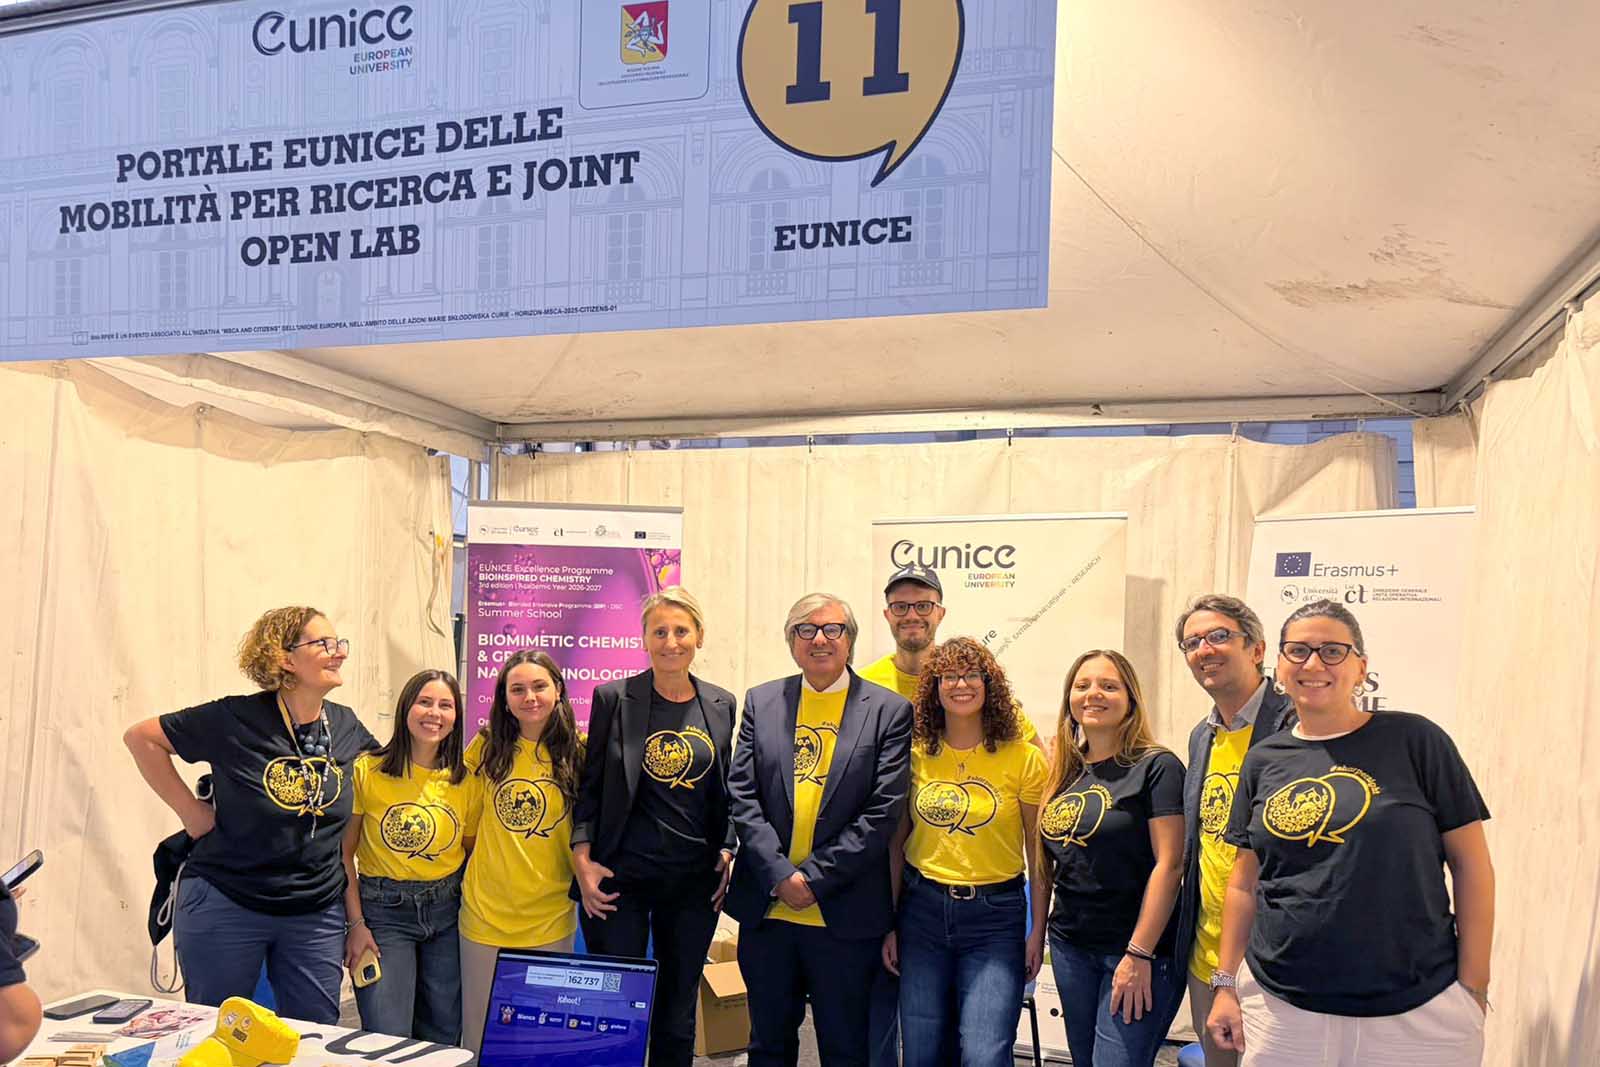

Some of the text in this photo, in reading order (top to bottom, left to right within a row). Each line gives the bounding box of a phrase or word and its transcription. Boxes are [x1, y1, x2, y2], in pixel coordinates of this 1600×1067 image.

[354, 47, 413, 63] EUROPEAN
[786, 0, 909, 104] 11
[350, 59, 413, 75] UNIVERSITY
[116, 107, 563, 183] PORTALE EUNICE DELLE
[59, 150, 640, 234] MOBILITÀ PER RICERCA E JOINT
[774, 216, 912, 251] EUNICE
[240, 224, 421, 267] OPEN LAB
[319, 322, 349, 330] EUROPEA,
[349, 319, 387, 328] NELL'AMBITO
[407, 316, 427, 324] AZIONI
[491, 311, 510, 319] CURIE
[479, 563, 614, 575] EUNICE Excellence Programme
[1313, 563, 1399, 577] Erasmus+
[479, 573, 592, 583] BIOINSPIRED CHEMISTRY
[490, 582, 514, 590] edition
[1344, 584, 1369, 604] ct
[478, 608, 562, 618] Summer School
[477, 634, 644, 649] BIOMIMETIC CHEMIST
[477, 651, 488, 662] &
[568, 975, 582, 985] 162
[583, 977, 600, 986] 737
